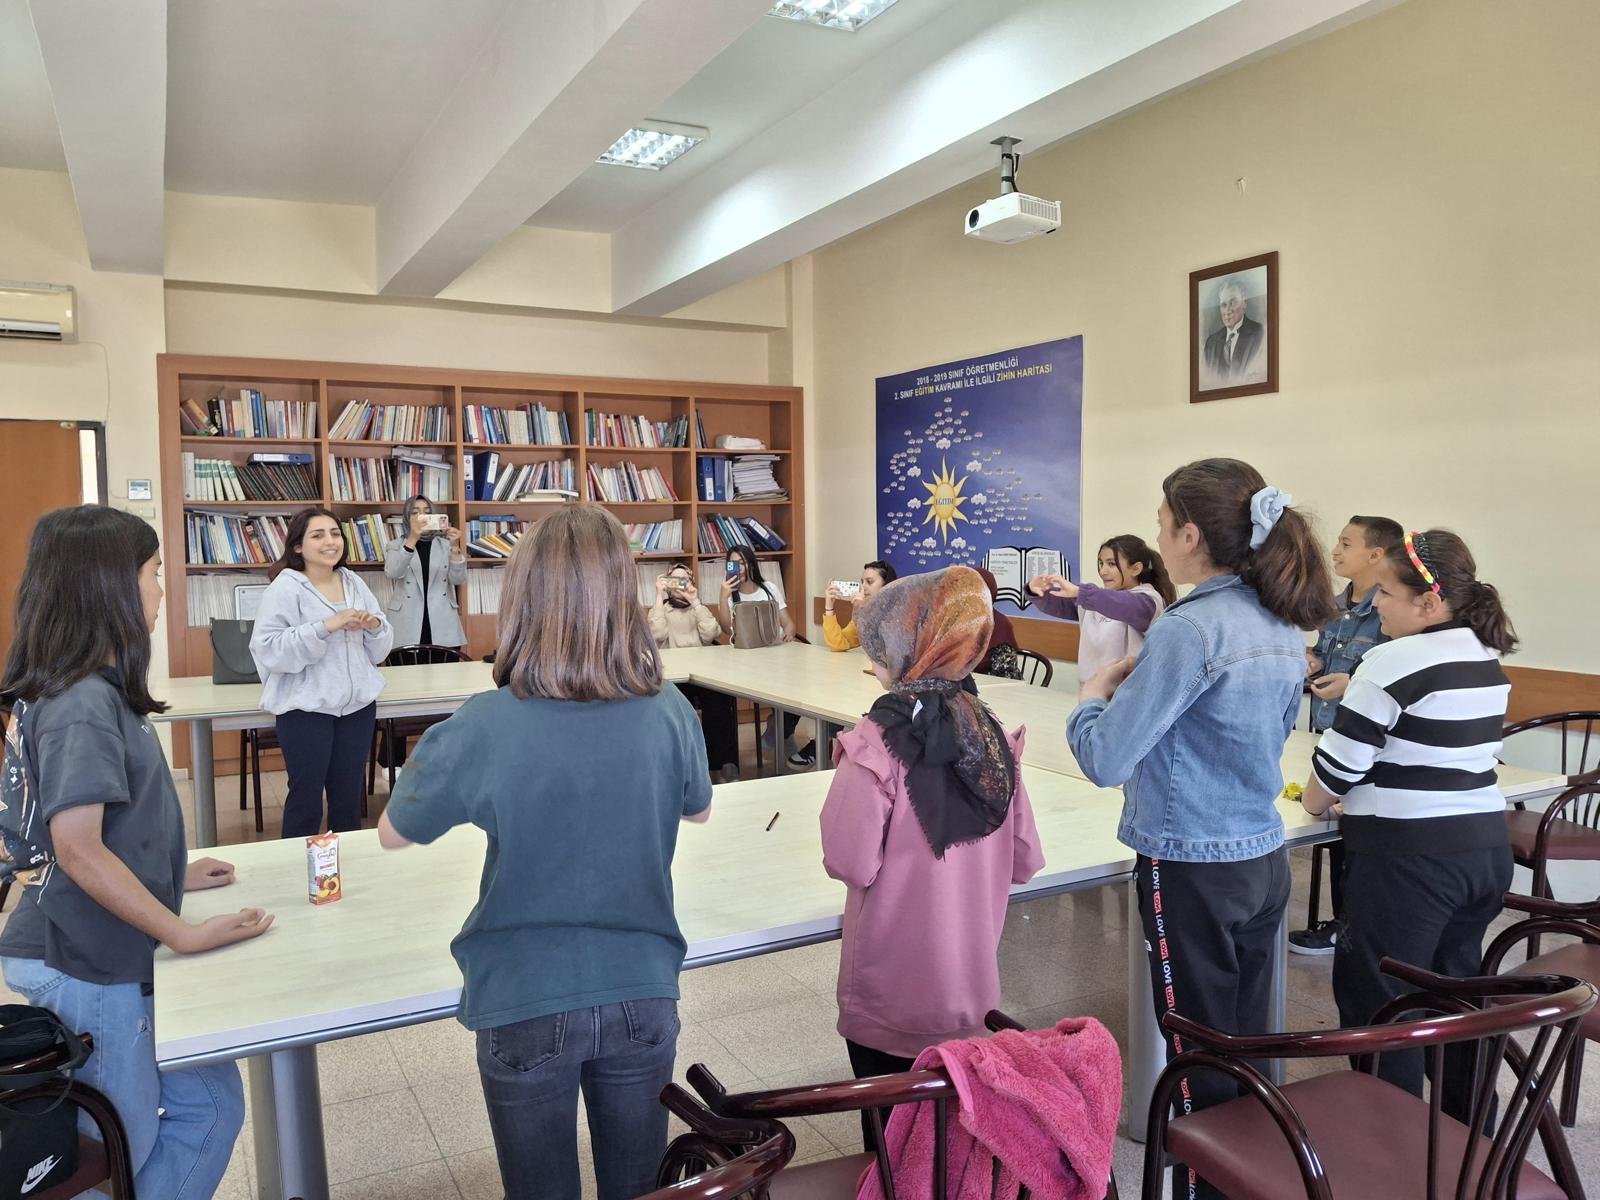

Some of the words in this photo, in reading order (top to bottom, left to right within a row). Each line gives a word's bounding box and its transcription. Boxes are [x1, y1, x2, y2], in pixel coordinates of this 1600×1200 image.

[933, 372, 948, 383] 2019
[948, 368, 965, 379] SINIF
[965, 355, 1019, 376] ÖĞRETMENLİĞİ
[899, 389, 914, 400] SINIF
[914, 385, 935, 397] EĞİTİM
[935, 381, 964, 393] KAVRAMI
[963, 377, 975, 388] İLE
[975, 372, 995, 386] İLGİLİ
[996, 369, 1016, 382] ZİHİN
[1152, 866, 1160, 890] LOVE
[1155, 914, 1165, 938] LOVE
[1162, 960, 1172, 984] LOVE
[26, 1154, 54, 1182] NIKE
